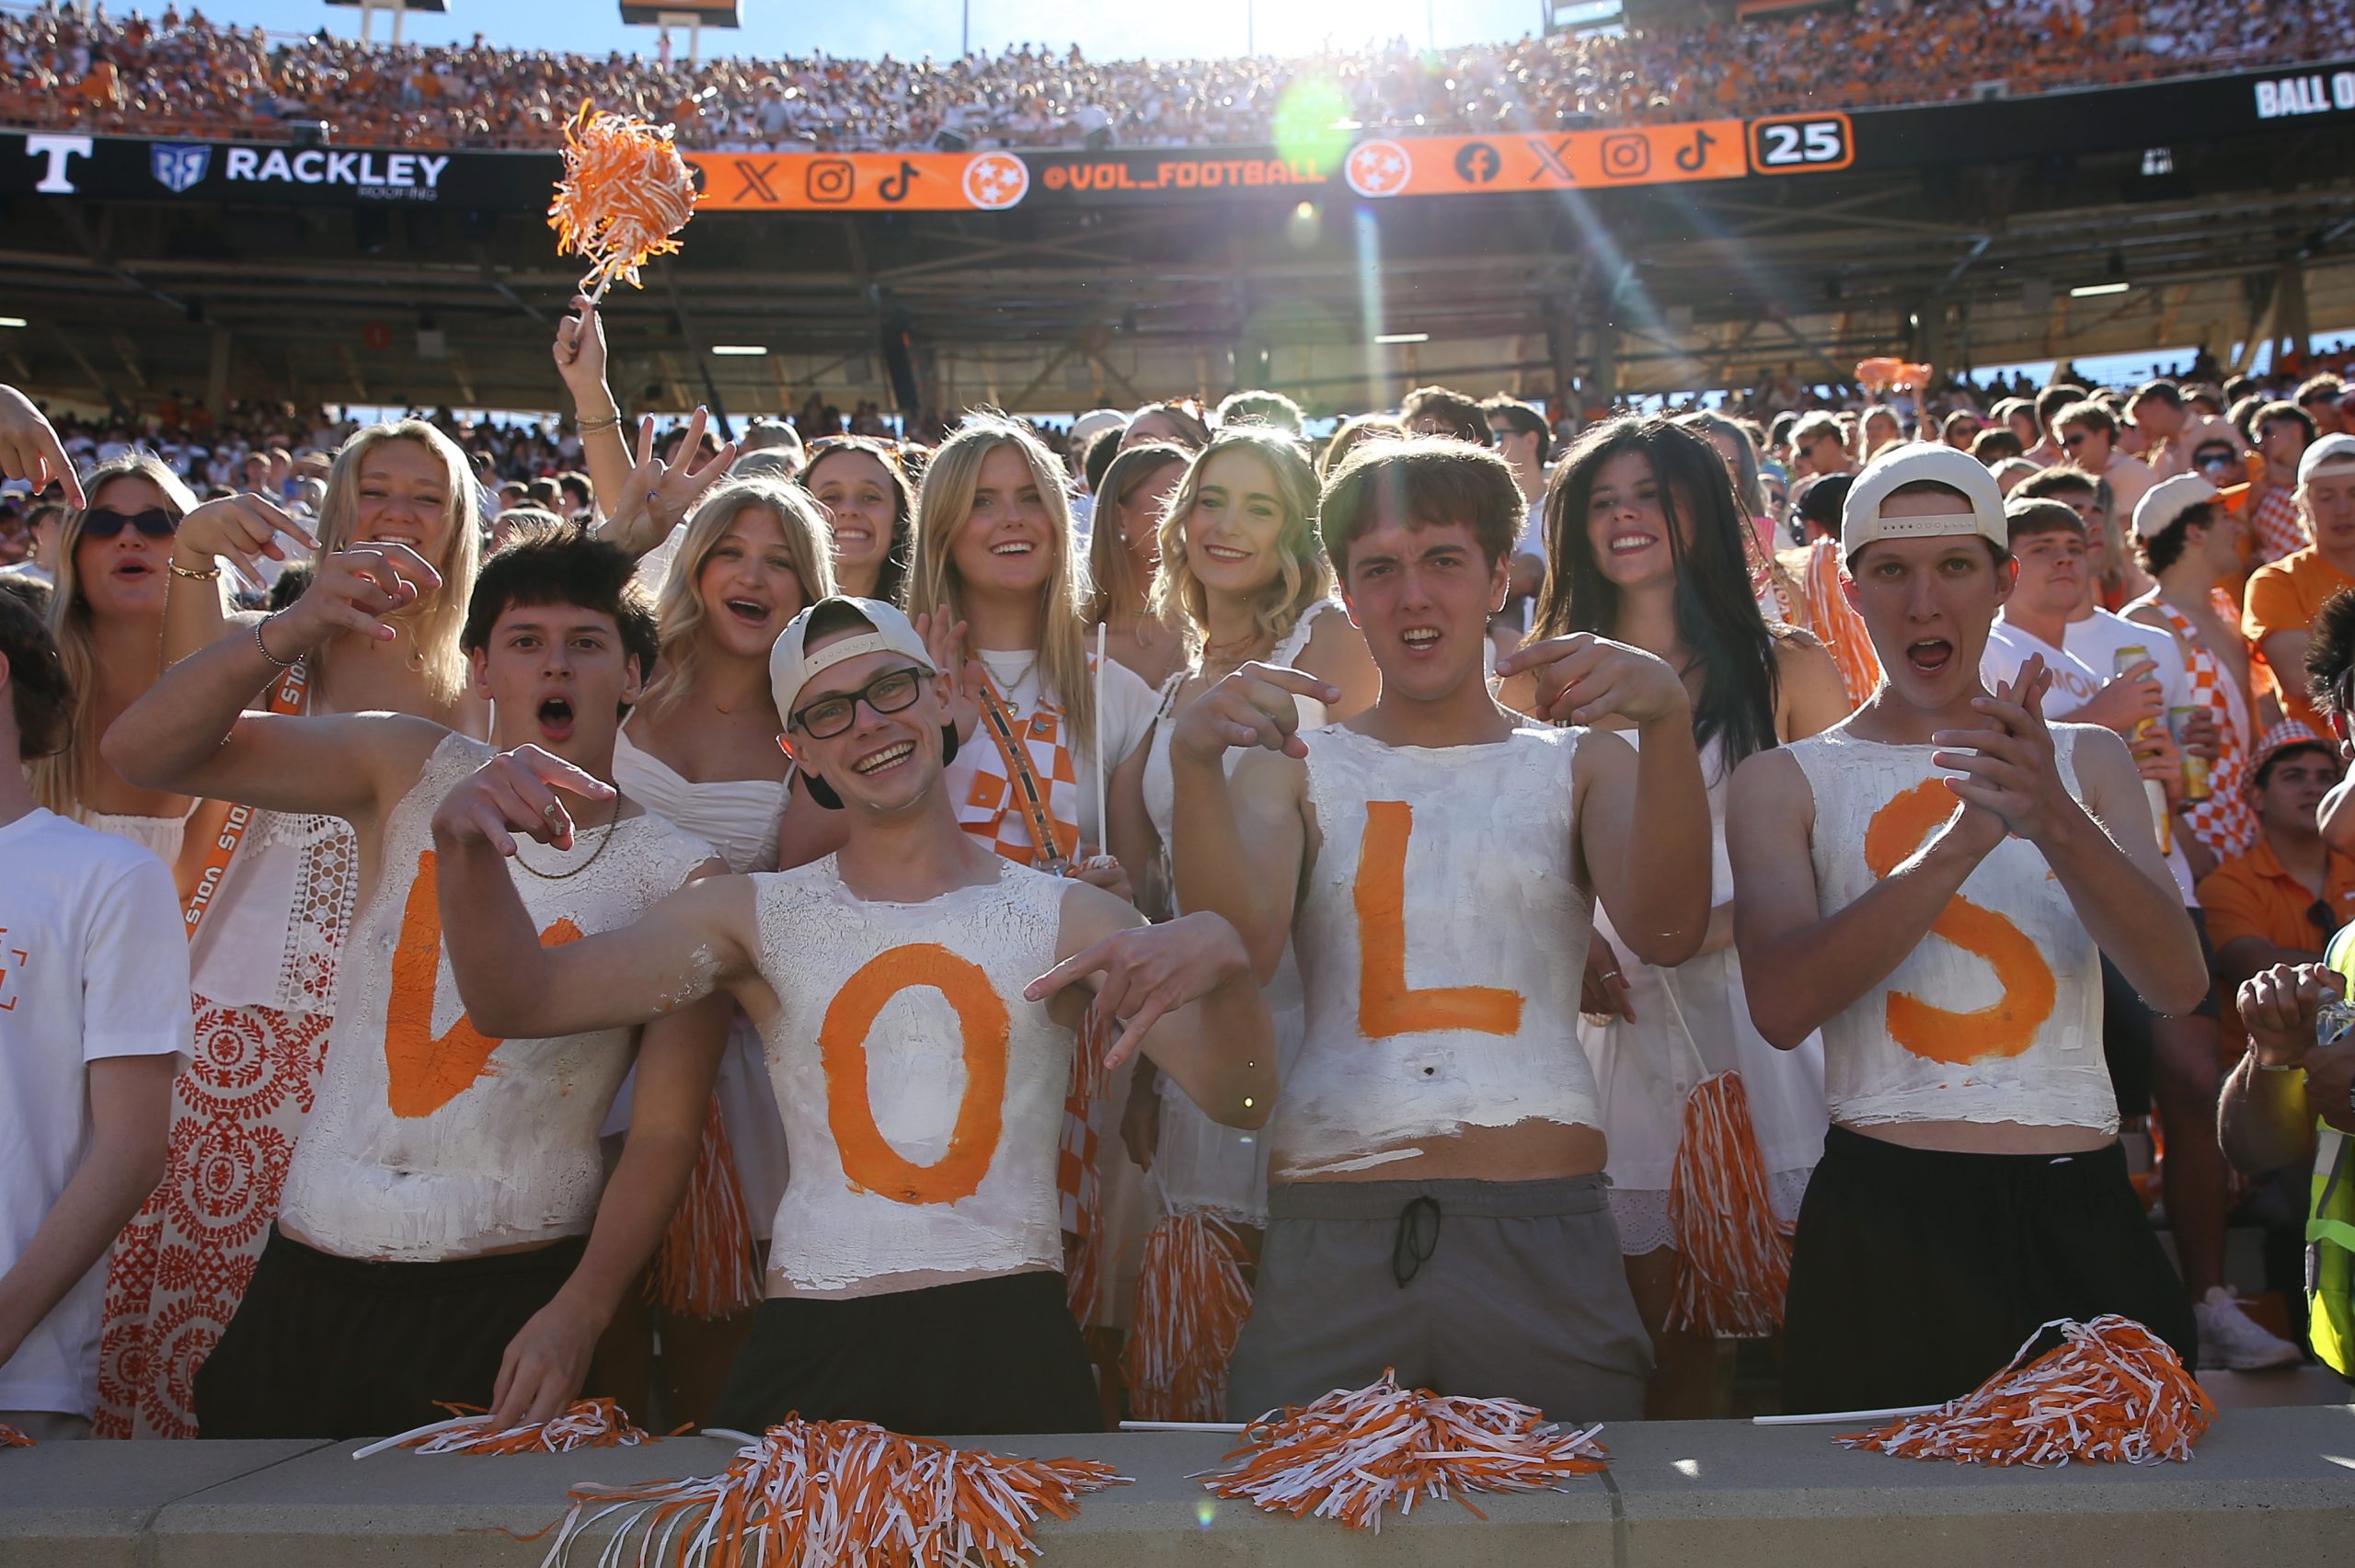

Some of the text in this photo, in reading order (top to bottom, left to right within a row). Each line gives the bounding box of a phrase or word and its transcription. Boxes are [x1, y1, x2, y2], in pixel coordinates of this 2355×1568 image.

[2254, 74, 2332, 119] BALL
[26, 134, 92, 193] T
[1764, 121, 1841, 165] 25
[226, 147, 450, 188] RACKLEY
[1043, 158, 1328, 190] @VOL_FOOTBALL
[281, 659, 307, 705] OLS
[218, 805, 251, 851] OLS
[185, 866, 223, 924] VOLS
[1353, 800, 1525, 1039] L
[1864, 777, 2057, 1066] S
[819, 943, 1011, 1207] O
